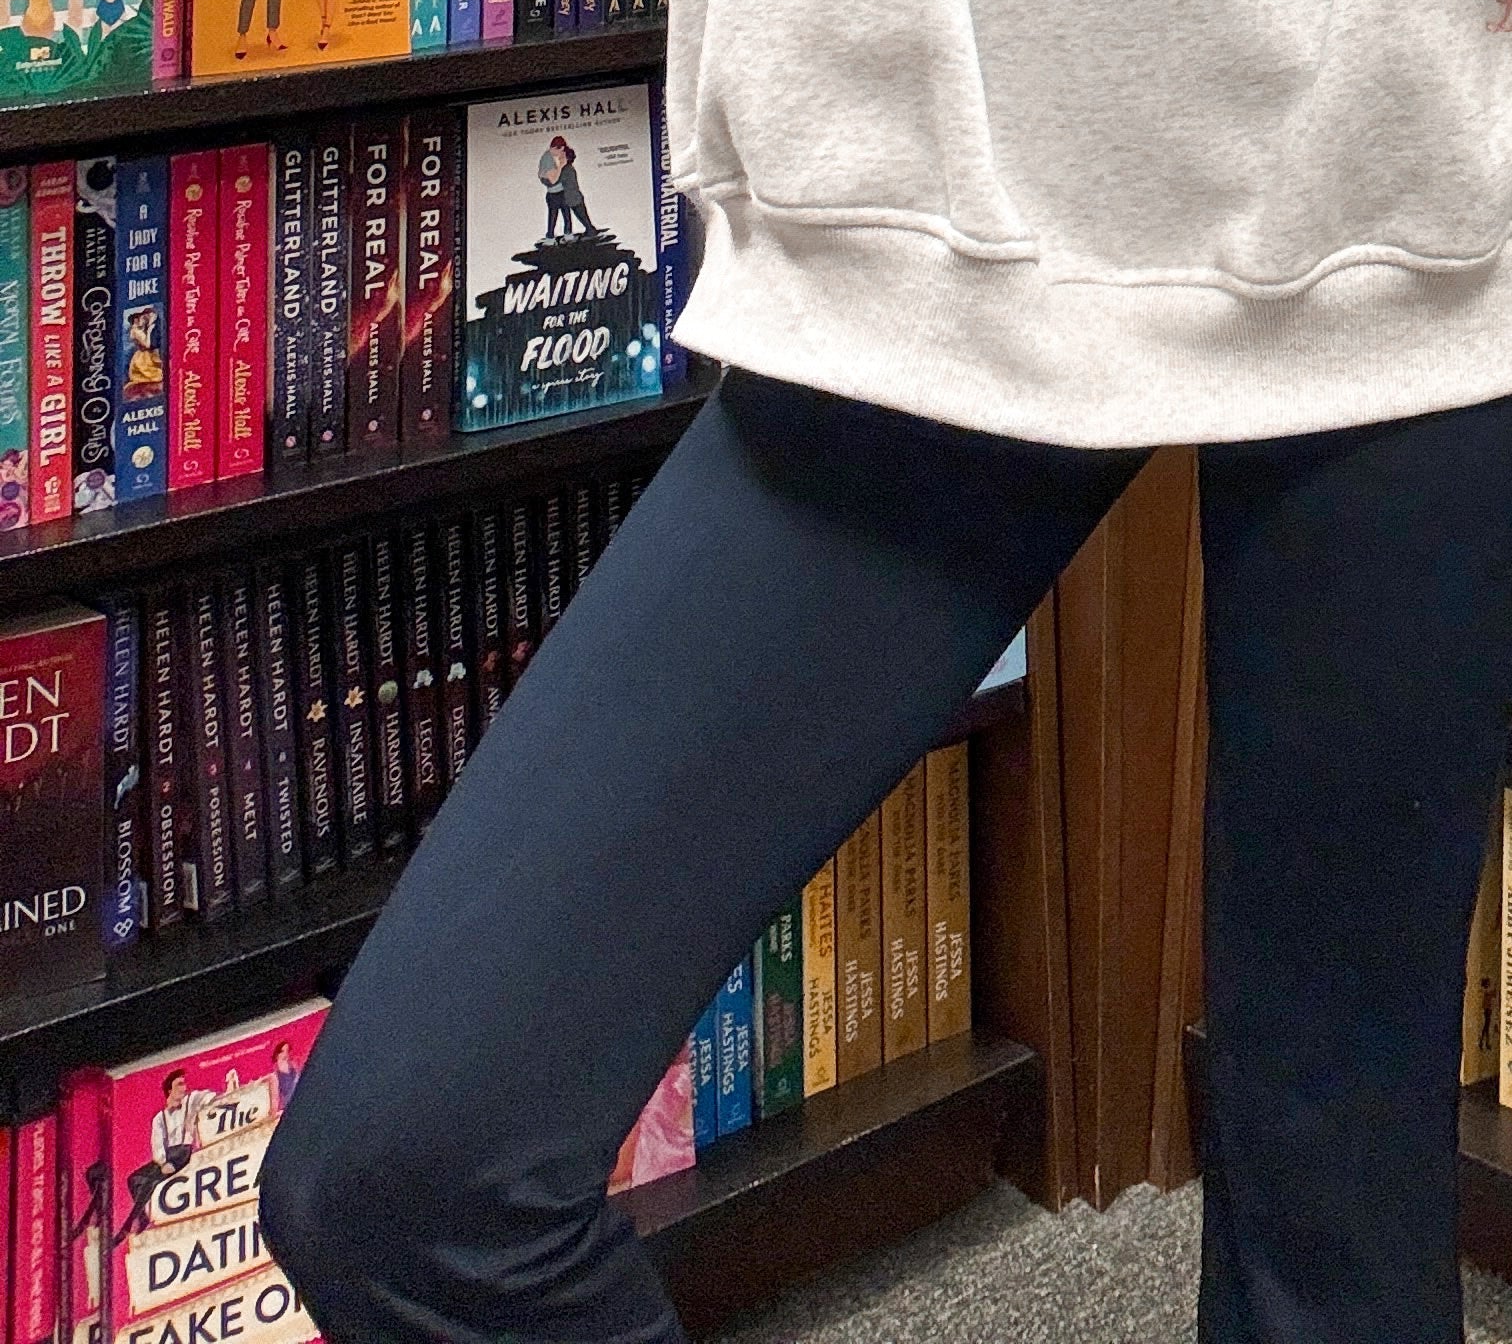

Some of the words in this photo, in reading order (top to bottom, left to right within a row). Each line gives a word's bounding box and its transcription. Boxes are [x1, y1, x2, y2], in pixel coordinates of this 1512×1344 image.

[498, 104, 571, 128] ALEXIS
[580, 100, 628, 117] HALL
[420, 136, 441, 198] FOR
[419, 209, 440, 290] REAL
[40, 227, 67, 326] THROW
[504, 263, 628, 315] WAITING
[423, 313, 433, 357] ALEXIS
[543, 315, 564, 330] FOR
[568, 309, 589, 326] THE
[44, 333, 61, 372] LIKE
[520, 326, 610, 372] FLOOD
[46, 373, 64, 387] A
[423, 359, 433, 392] HALL
[41, 393, 67, 468] GIRL
[199, 596, 213, 667] HELEN
[204, 673, 219, 748] HARDT
[209, 787, 226, 886] POSSESSION
